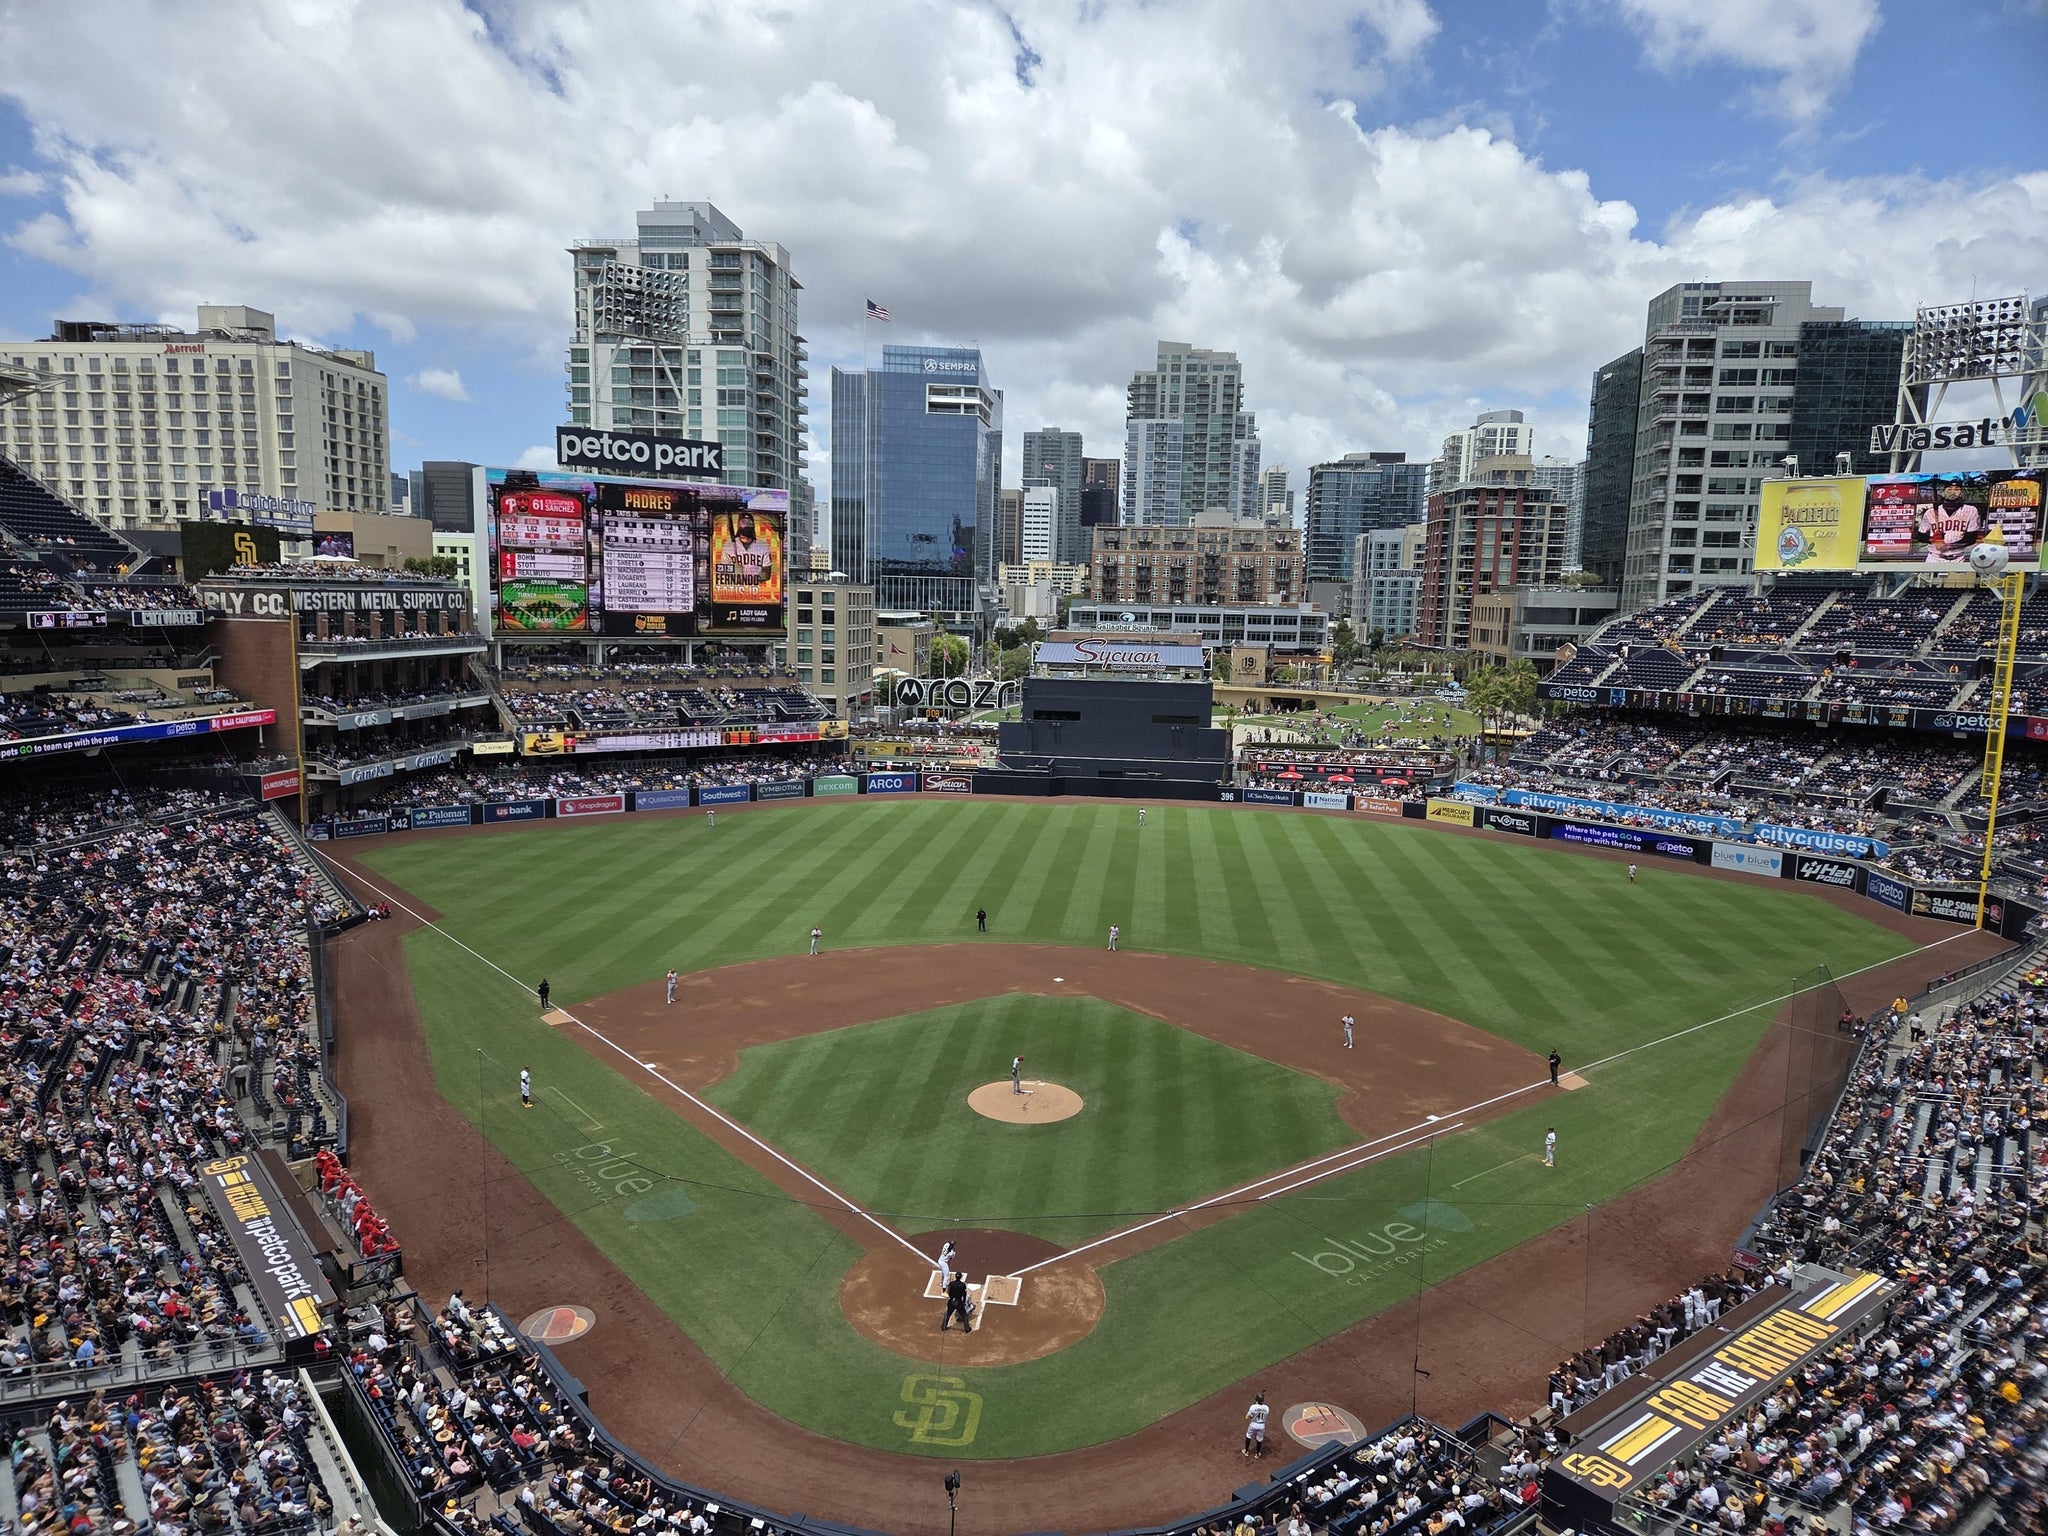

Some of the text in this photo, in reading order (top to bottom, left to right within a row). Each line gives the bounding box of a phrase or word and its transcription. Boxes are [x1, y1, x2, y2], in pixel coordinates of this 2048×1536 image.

[939, 362, 976, 371] SEMPRA
[1877, 418, 1995, 451] Viasat
[561, 433, 719, 470] petco park
[532, 499, 544, 511] 61
[625, 492, 671, 510] PADRES
[716, 574, 759, 586] FERNANDO
[254, 593, 290, 615] CO.
[292, 592, 465, 610] WESTERN METAL SUPPLY CO.
[142, 611, 198, 626] CUTWATER
[1074, 638, 1162, 670] Sycuan
[1244, 657, 1254, 667] 19
[928, 680, 1016, 708] razr
[1563, 686, 1597, 698] petco
[176, 722, 197, 734] petco
[1, 735, 118, 759] pets GO to team up with the pros
[869, 779, 902, 789] ARCO
[926, 775, 967, 791] Sycuan
[702, 790, 741, 800] Southwest
[1220, 792, 1234, 802] 396
[1319, 796, 1345, 804] National
[509, 805, 532, 814] bank
[578, 801, 617, 810] Snapdragon
[1442, 807, 1470, 816] MERCURY
[428, 809, 467, 820] Palomar
[1442, 813, 1470, 821] INSURANCE
[1490, 815, 1529, 827] EVOTEK
[391, 818, 408, 829] 342
[1564, 833, 1582, 841] team
[1583, 836, 1593, 844] up
[1593, 838, 1610, 846] with
[1611, 839, 1623, 847] the
[1565, 824, 1588, 834] Where
[1589, 828, 1601, 836] the
[1602, 831, 1618, 839] pets
[1620, 833, 1632, 841] GO
[1760, 826, 1869, 853] citycruises
[1667, 842, 1694, 854] petco
[1714, 850, 1769, 866] blue blue
[1817, 874, 1852, 886] POWER
[1879, 882, 1904, 901] petco
[1931, 905, 1957, 917] CHEESE
[1959, 910, 1969, 918] ON
[1932, 897, 1954, 908] SLAP
[1955, 901, 1979, 912] SOME
[570, 1138, 653, 1196] blue
[553, 1152, 612, 1203] CALIFORNIA
[224, 1182, 271, 1223] WELCOME
[245, 1225, 292, 1265] petco
[1291, 1222, 1427, 1278] blue
[1346, 1238, 1449, 1287] CALIFORNIA
[264, 1261, 312, 1300] park
[1646, 1308, 1839, 1430] FOR THE FAITHFUL
[1256, 1411, 1265, 1420] 41
